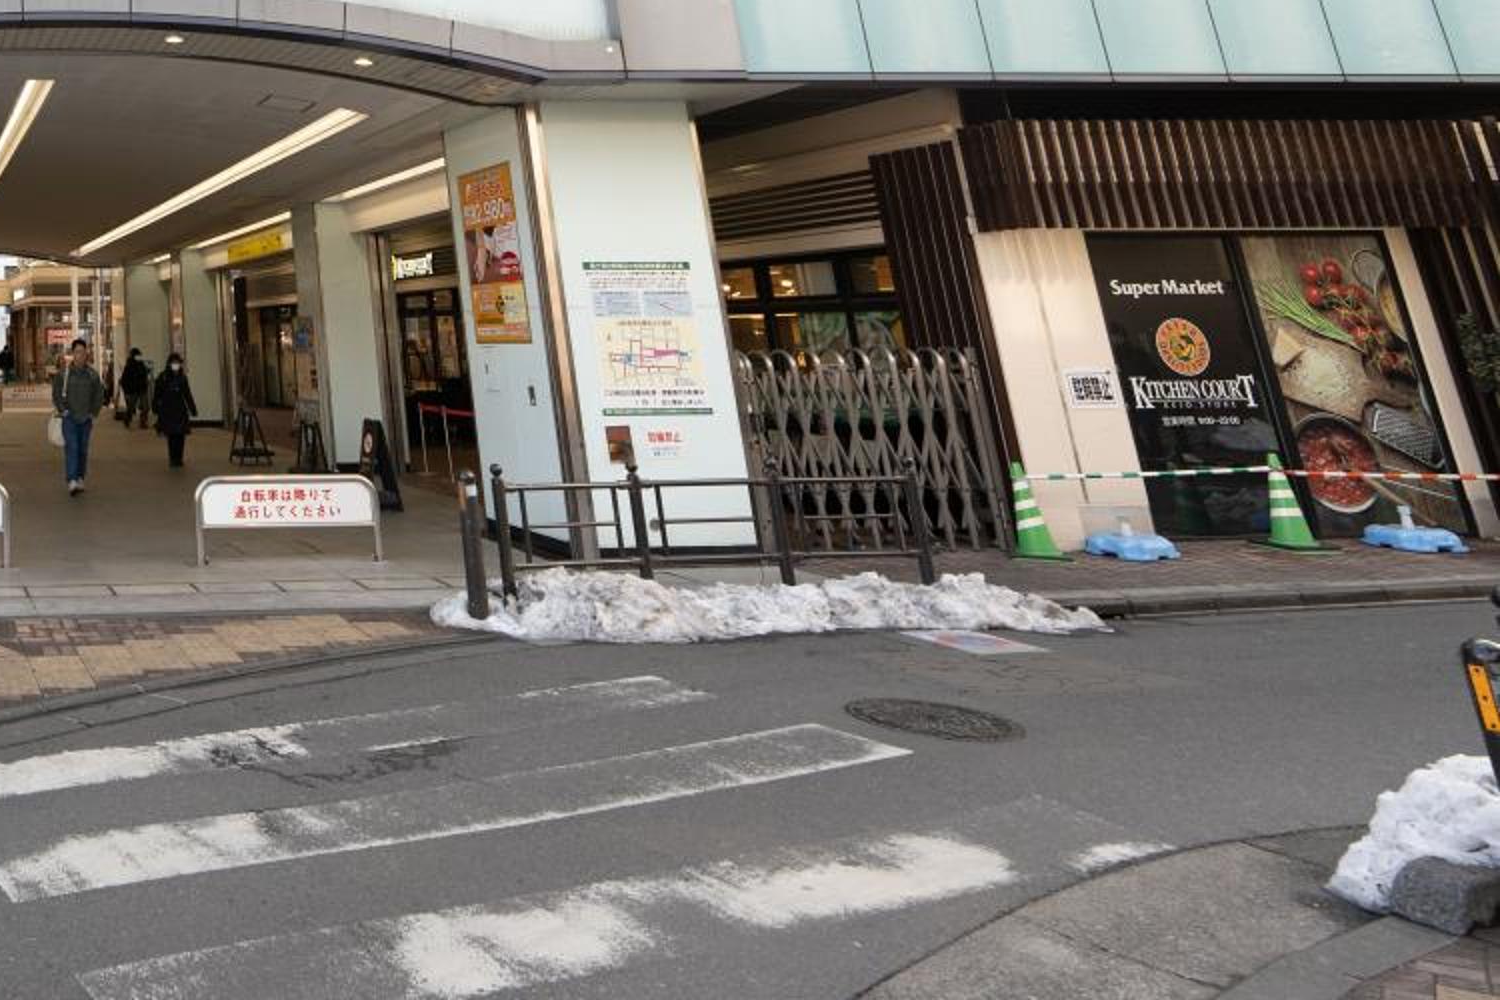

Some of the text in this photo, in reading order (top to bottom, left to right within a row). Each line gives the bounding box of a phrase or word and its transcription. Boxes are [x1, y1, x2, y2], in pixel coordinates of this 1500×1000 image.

[1109, 279, 1225, 299] Super Market
[1200, 375, 1259, 408] COURT
[241, 488, 333, 503] 自転車は降りて
[234, 505, 341, 519] 通行してください
